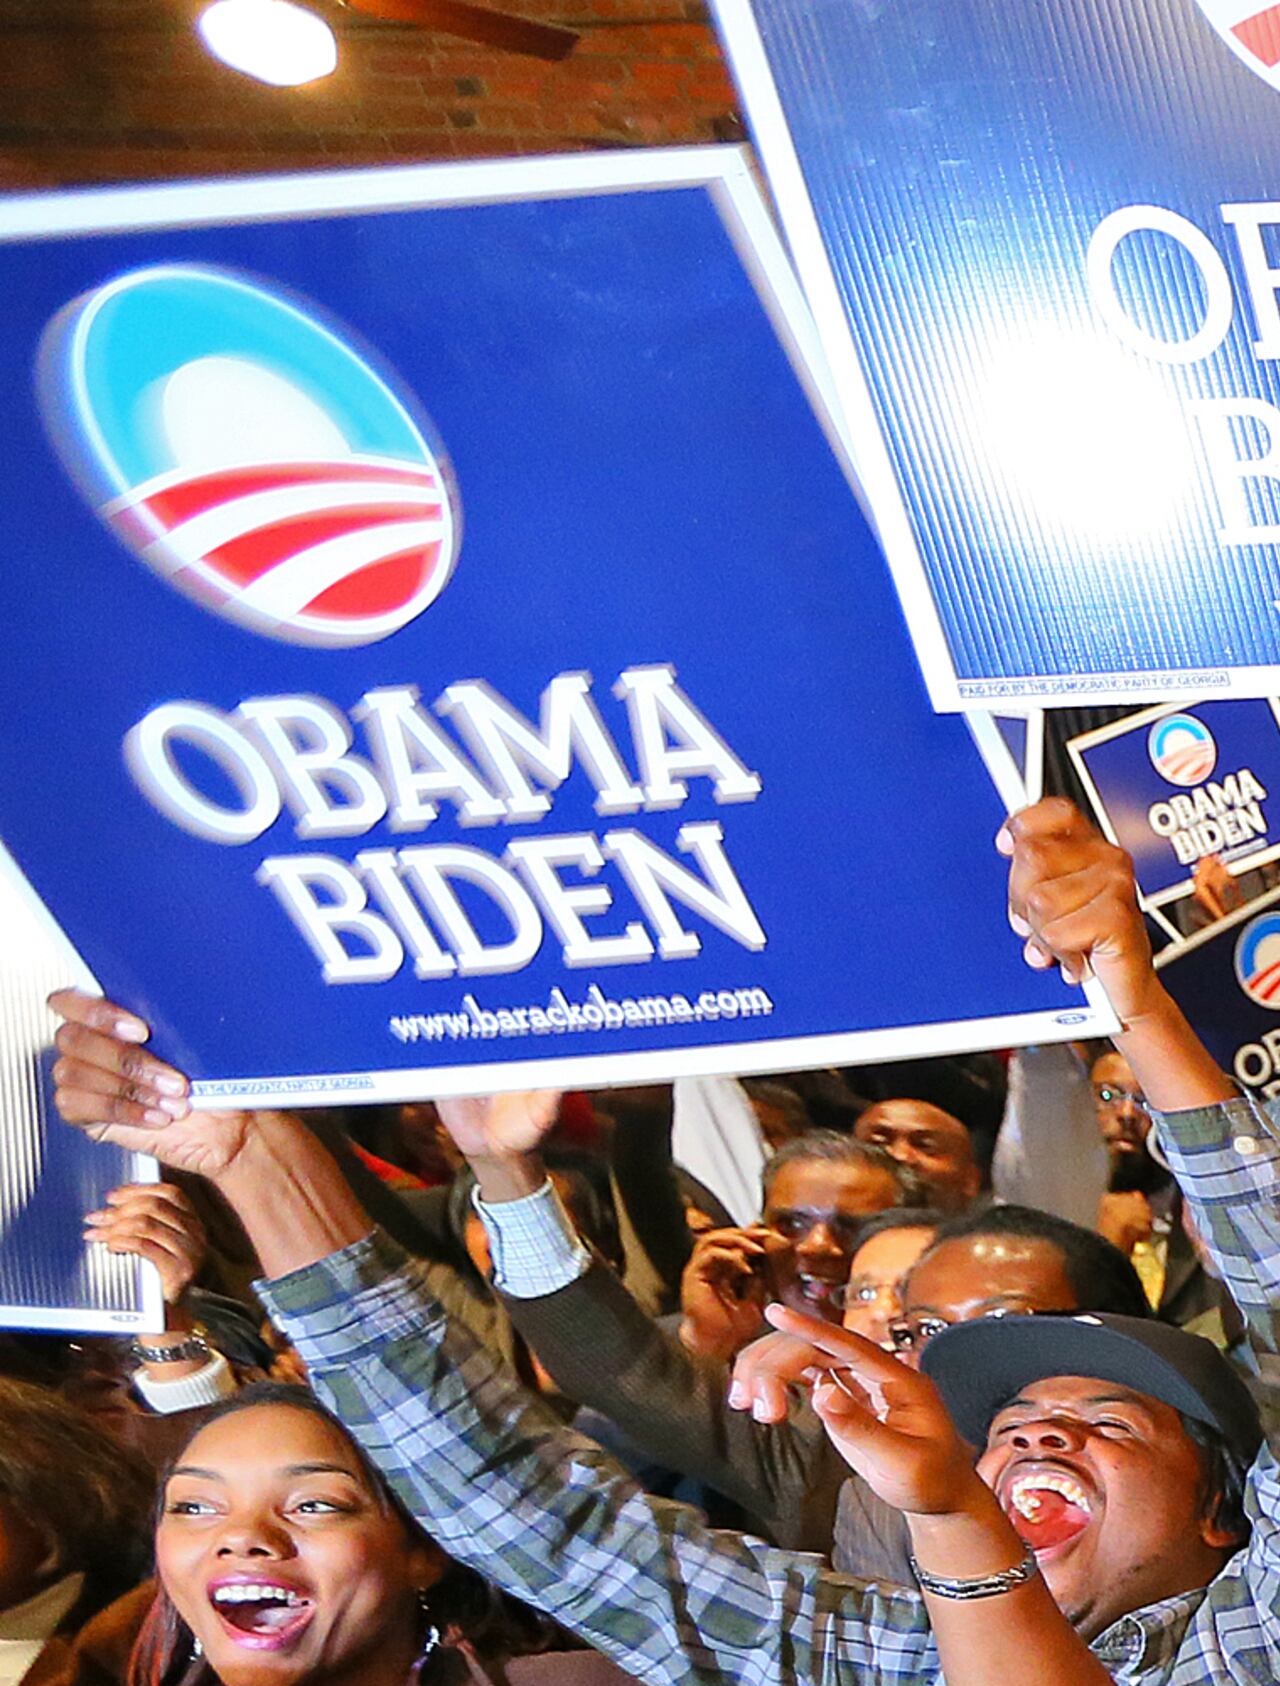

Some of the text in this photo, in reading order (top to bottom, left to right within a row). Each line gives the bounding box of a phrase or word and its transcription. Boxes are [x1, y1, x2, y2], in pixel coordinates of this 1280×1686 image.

[123, 661, 762, 846] OBAMA
[1148, 767, 1268, 838] OBAMA
[1169, 800, 1268, 866] BIDEN
[258, 820, 766, 985] BIDEN
[389, 982, 773, 1043] www.barackobama.com
